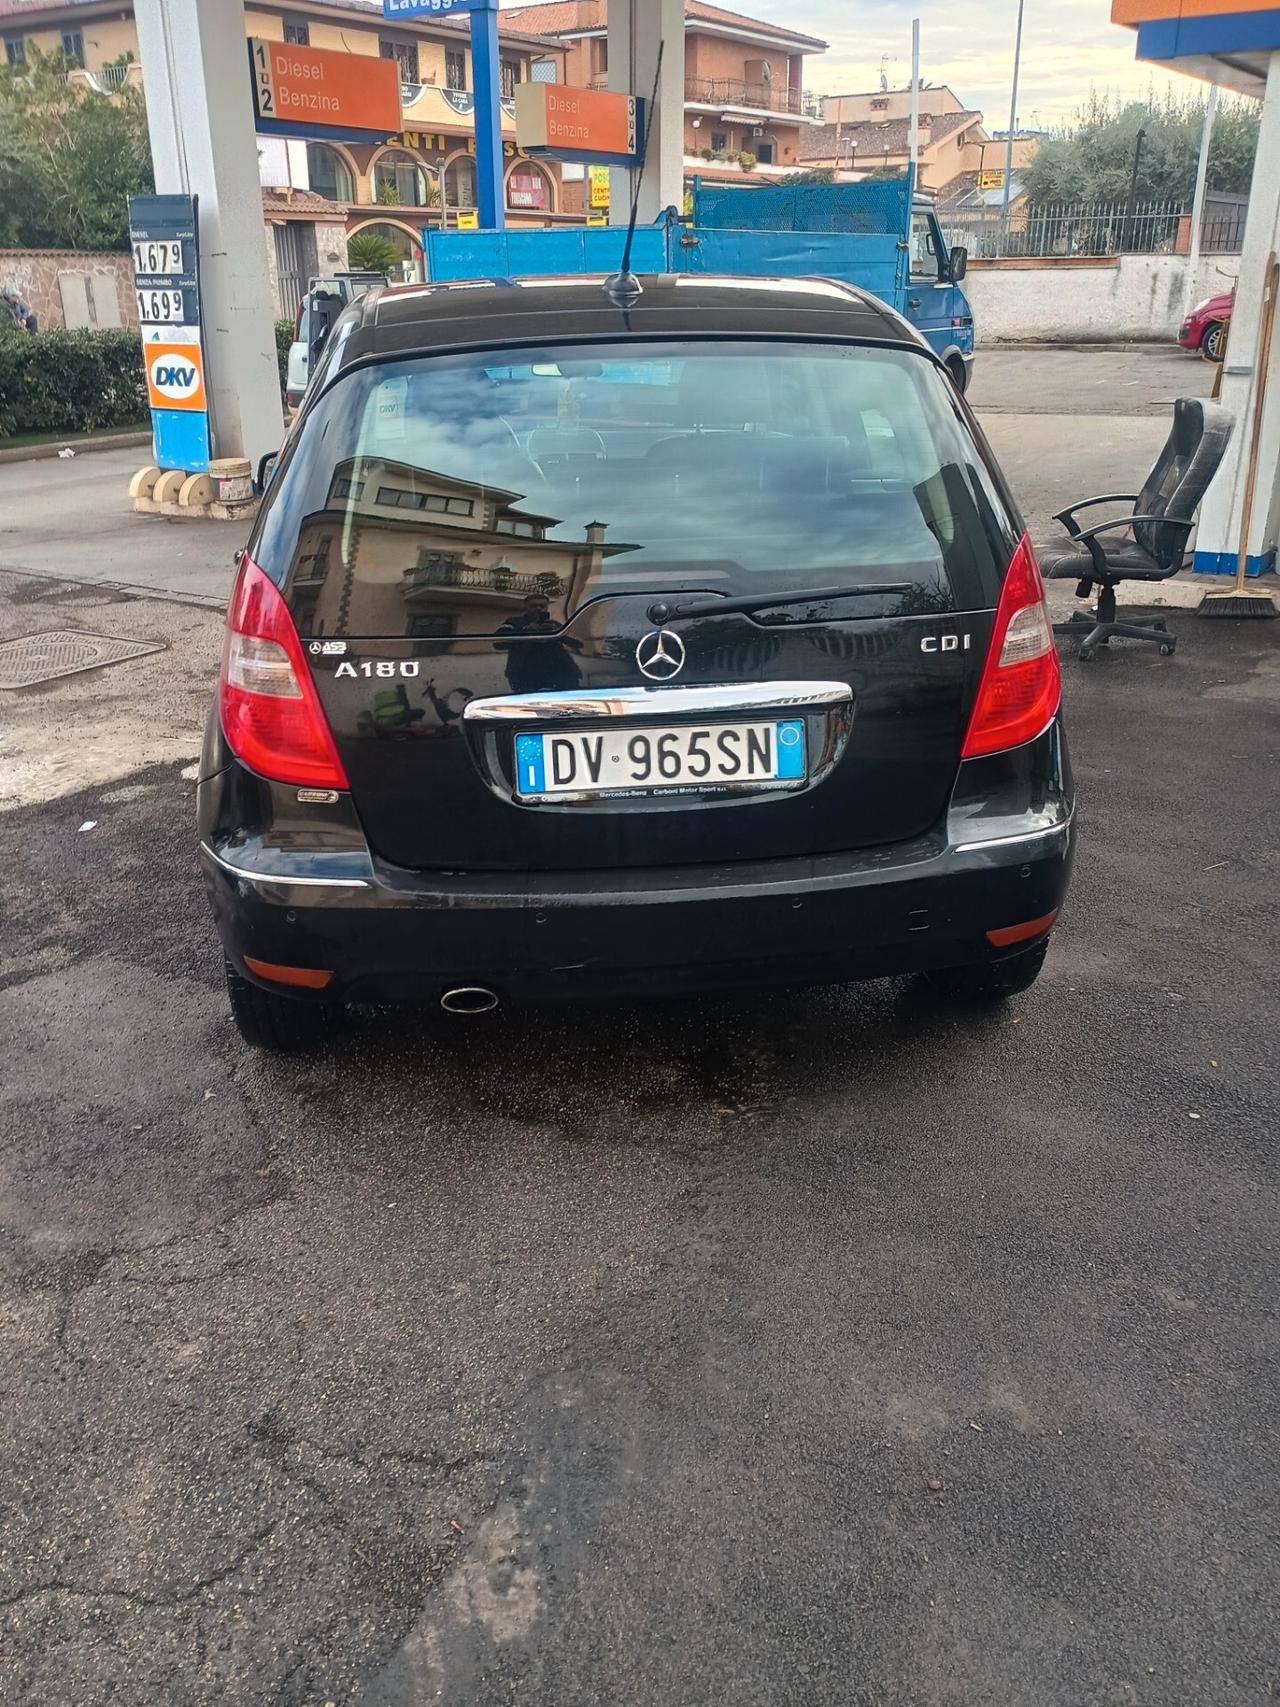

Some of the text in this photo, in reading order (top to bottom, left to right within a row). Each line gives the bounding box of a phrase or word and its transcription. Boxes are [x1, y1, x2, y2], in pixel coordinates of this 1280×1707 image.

[276, 56, 325, 80] Diesel
[279, 86, 340, 111] Benzina
[548, 95, 580, 113] Diesel
[549, 119, 590, 138] Benzina
[135, 244, 181, 273] 1,679
[138, 292, 181, 320] 1,699
[156, 366, 195, 387] DKV
[920, 634, 971, 653] CDI
[600, 790, 647, 798] Mercedes-Benz
